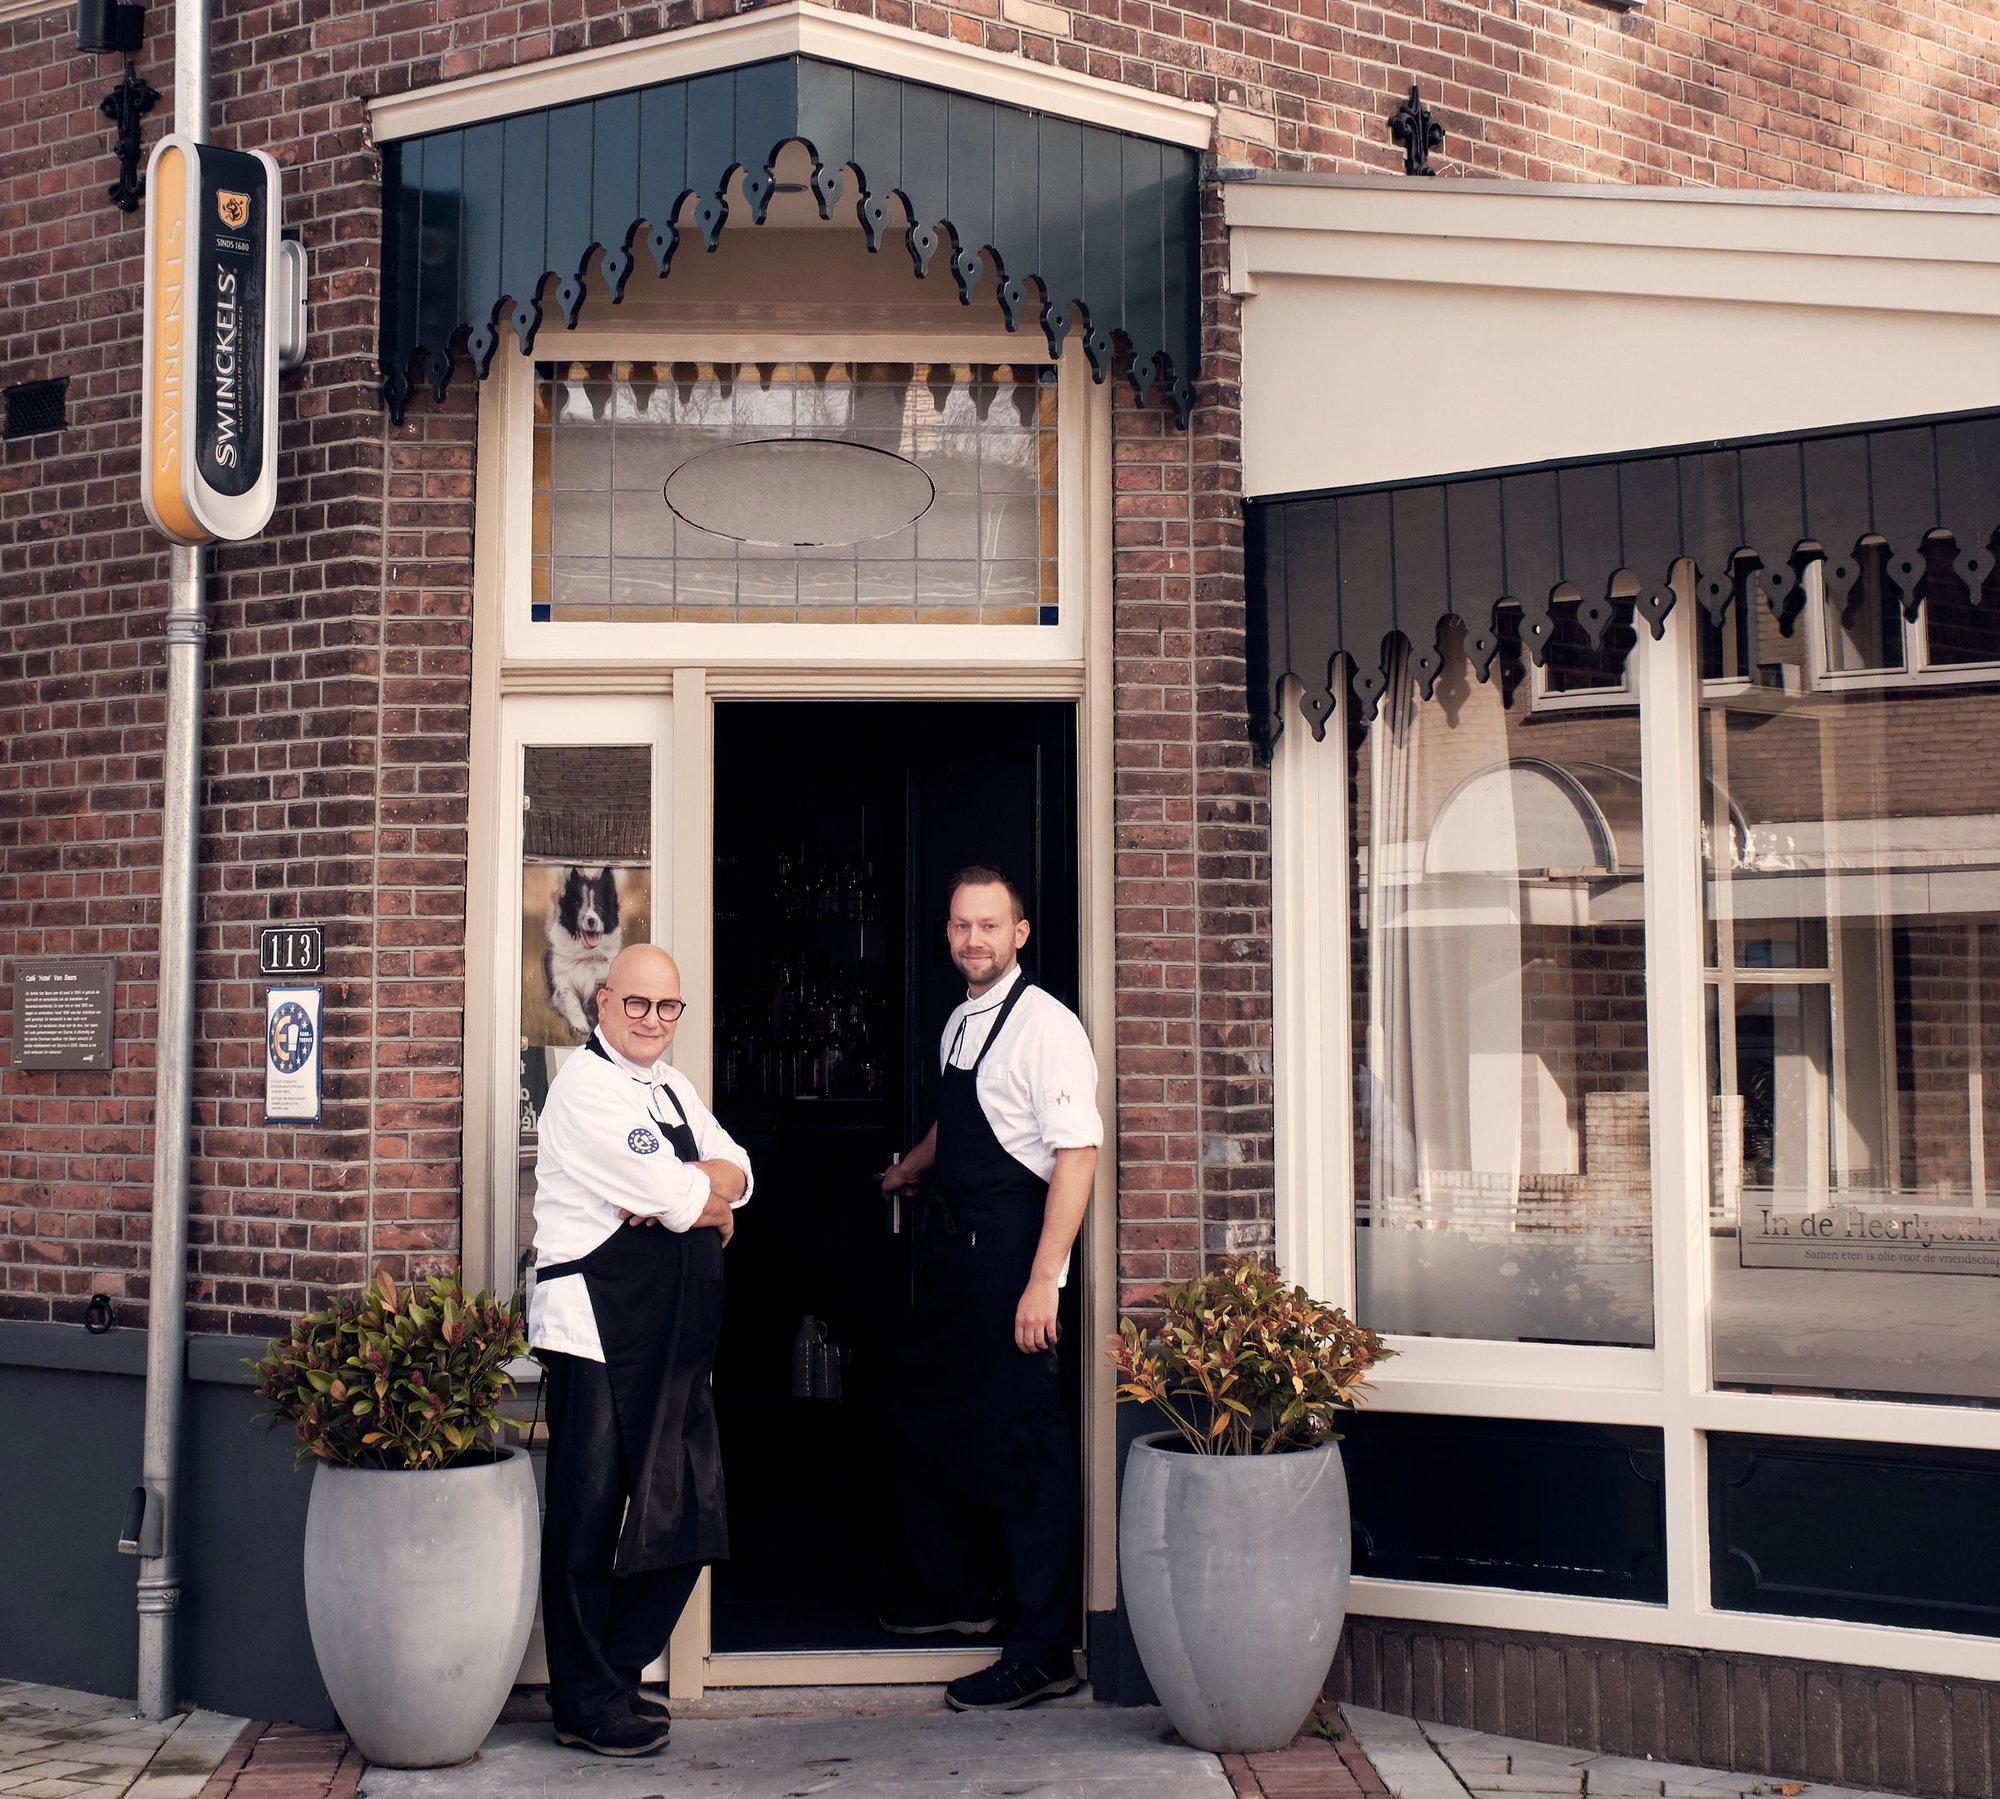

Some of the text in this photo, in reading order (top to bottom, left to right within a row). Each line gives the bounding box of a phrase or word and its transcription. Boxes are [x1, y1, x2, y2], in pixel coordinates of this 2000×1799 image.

[216, 238, 250, 251] SINDS 1680
[271, 934, 311, 967] 113
[1760, 1209, 1791, 1236] In
[1800, 1213, 1834, 1237] de
[1804, 1249, 1839, 1260] Samen
[1841, 1251, 1863, 1261] eten
[1866, 1252, 1875, 1262] is
[1877, 1251, 1896, 1262] olie
[1898, 1254, 1921, 1263] voor
[1923, 1252, 1936, 1263] de
